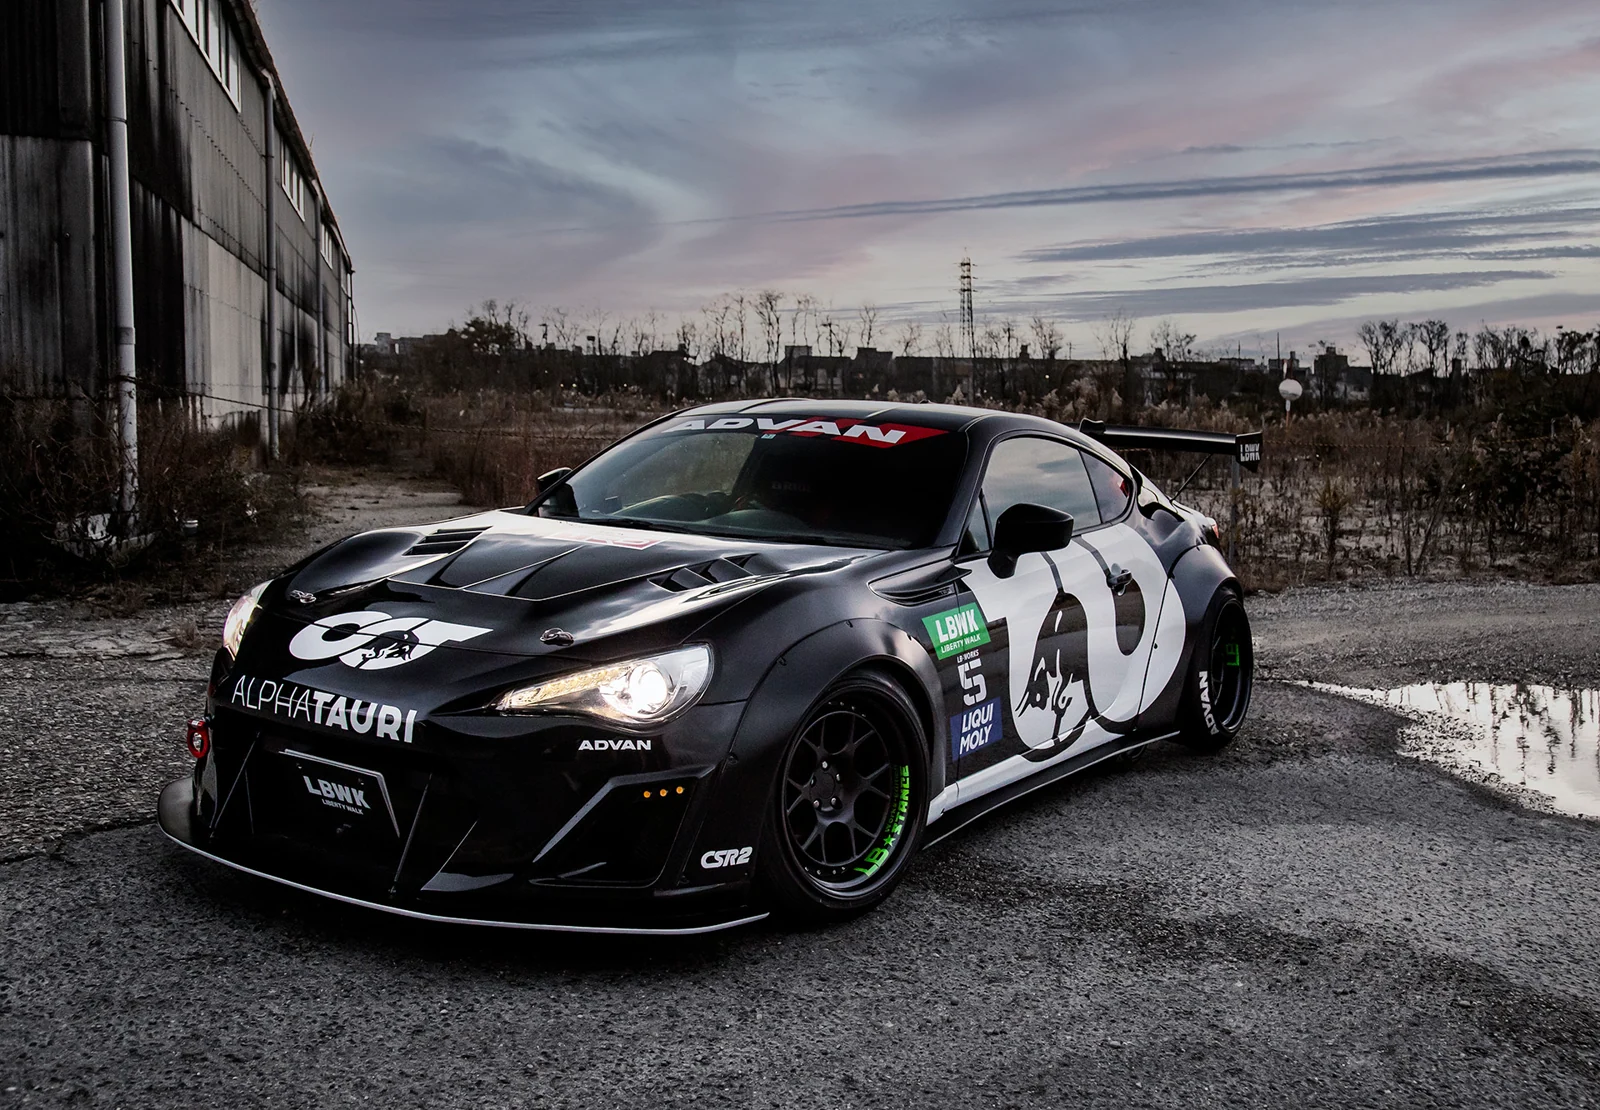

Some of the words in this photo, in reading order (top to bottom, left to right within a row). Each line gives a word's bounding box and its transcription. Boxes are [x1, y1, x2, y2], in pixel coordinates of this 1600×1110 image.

[661, 418, 906, 444] ADVAN
[935, 609, 979, 643] LBWK
[941, 640, 964, 653] LIBERTY
[964, 634, 981, 645] WALK
[957, 658, 987, 706] 5
[231, 674, 417, 743] ALPHATAURI
[1199, 670, 1219, 735] ADVAN
[961, 703, 994, 733] LIQUI
[578, 740, 651, 750] ADVAN
[959, 724, 993, 755] MOLY
[303, 775, 371, 809] LBWK
[321, 798, 346, 810] LIBERTY
[346, 804, 364, 815] WALK
[701, 847, 753, 869] CSR2
